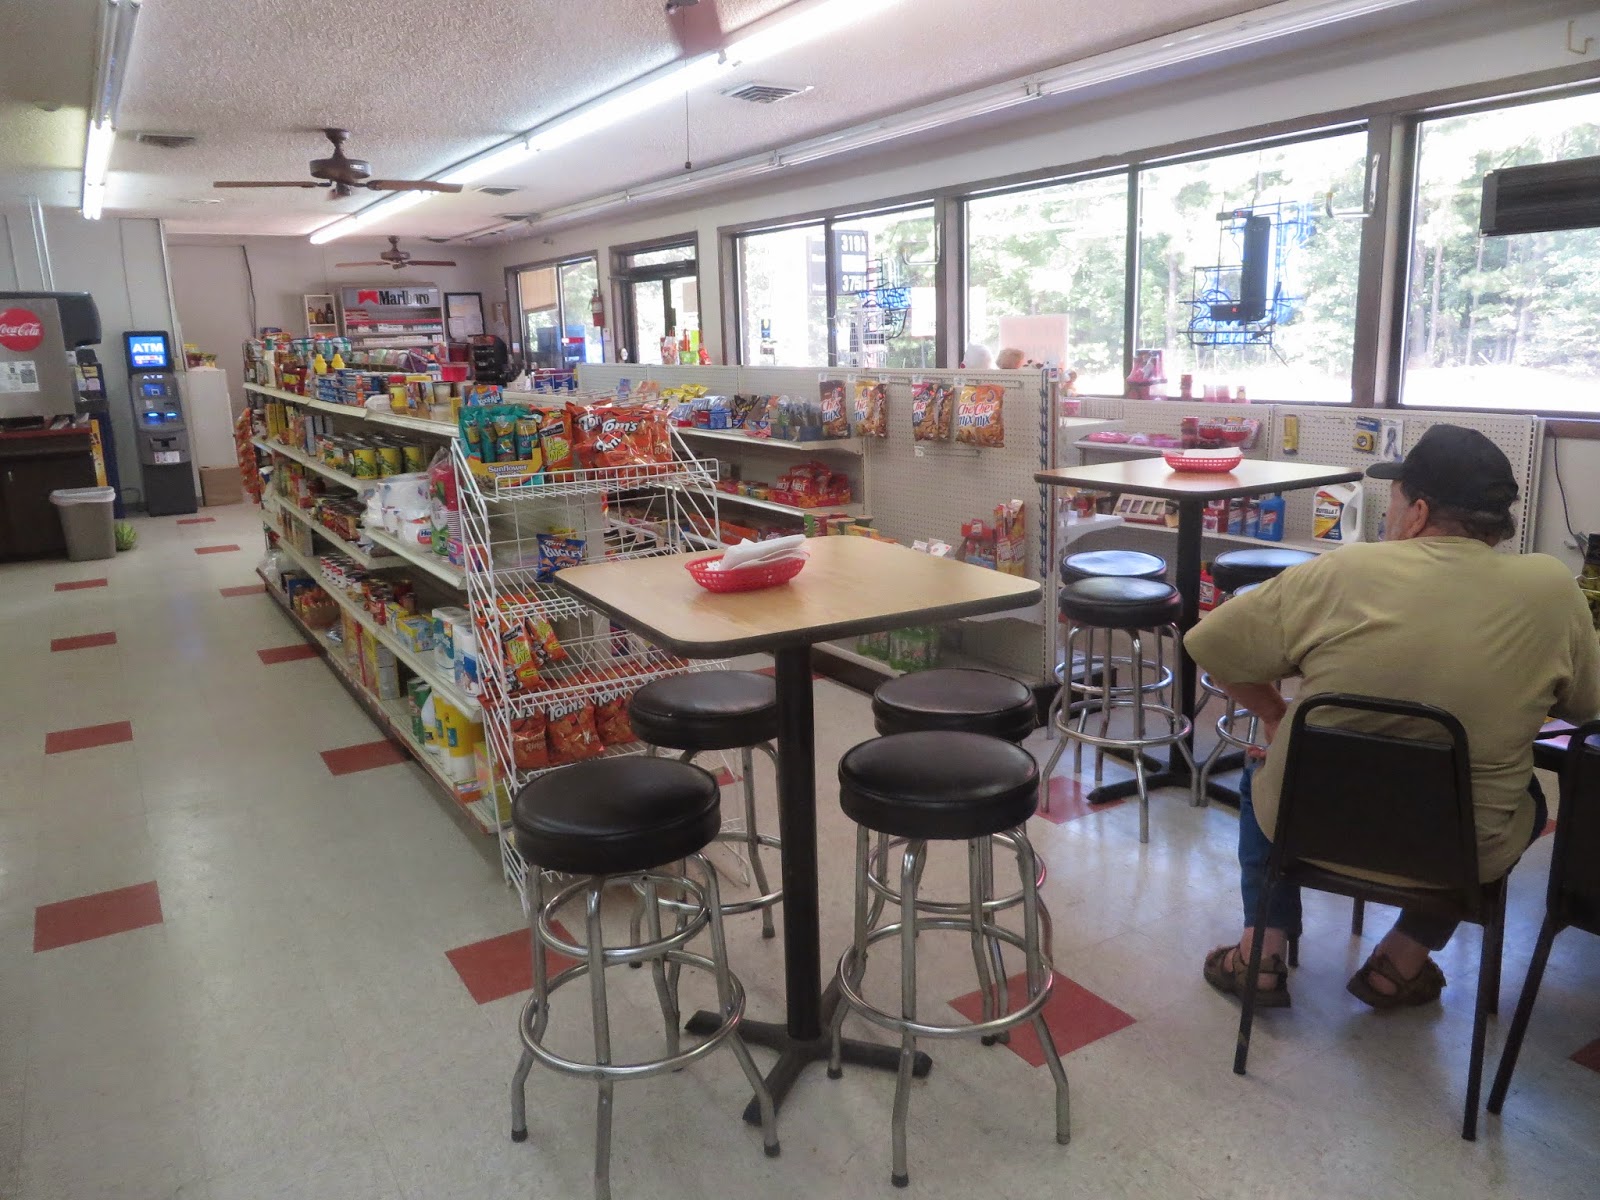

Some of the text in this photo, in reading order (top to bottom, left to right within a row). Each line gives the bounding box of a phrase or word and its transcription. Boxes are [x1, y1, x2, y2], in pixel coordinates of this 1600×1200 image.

[132, 342, 164, 353] ATM
[602, 418, 639, 434] Tom's
[488, 464, 528, 473] Sunflower
[549, 700, 586, 721] Tom's
